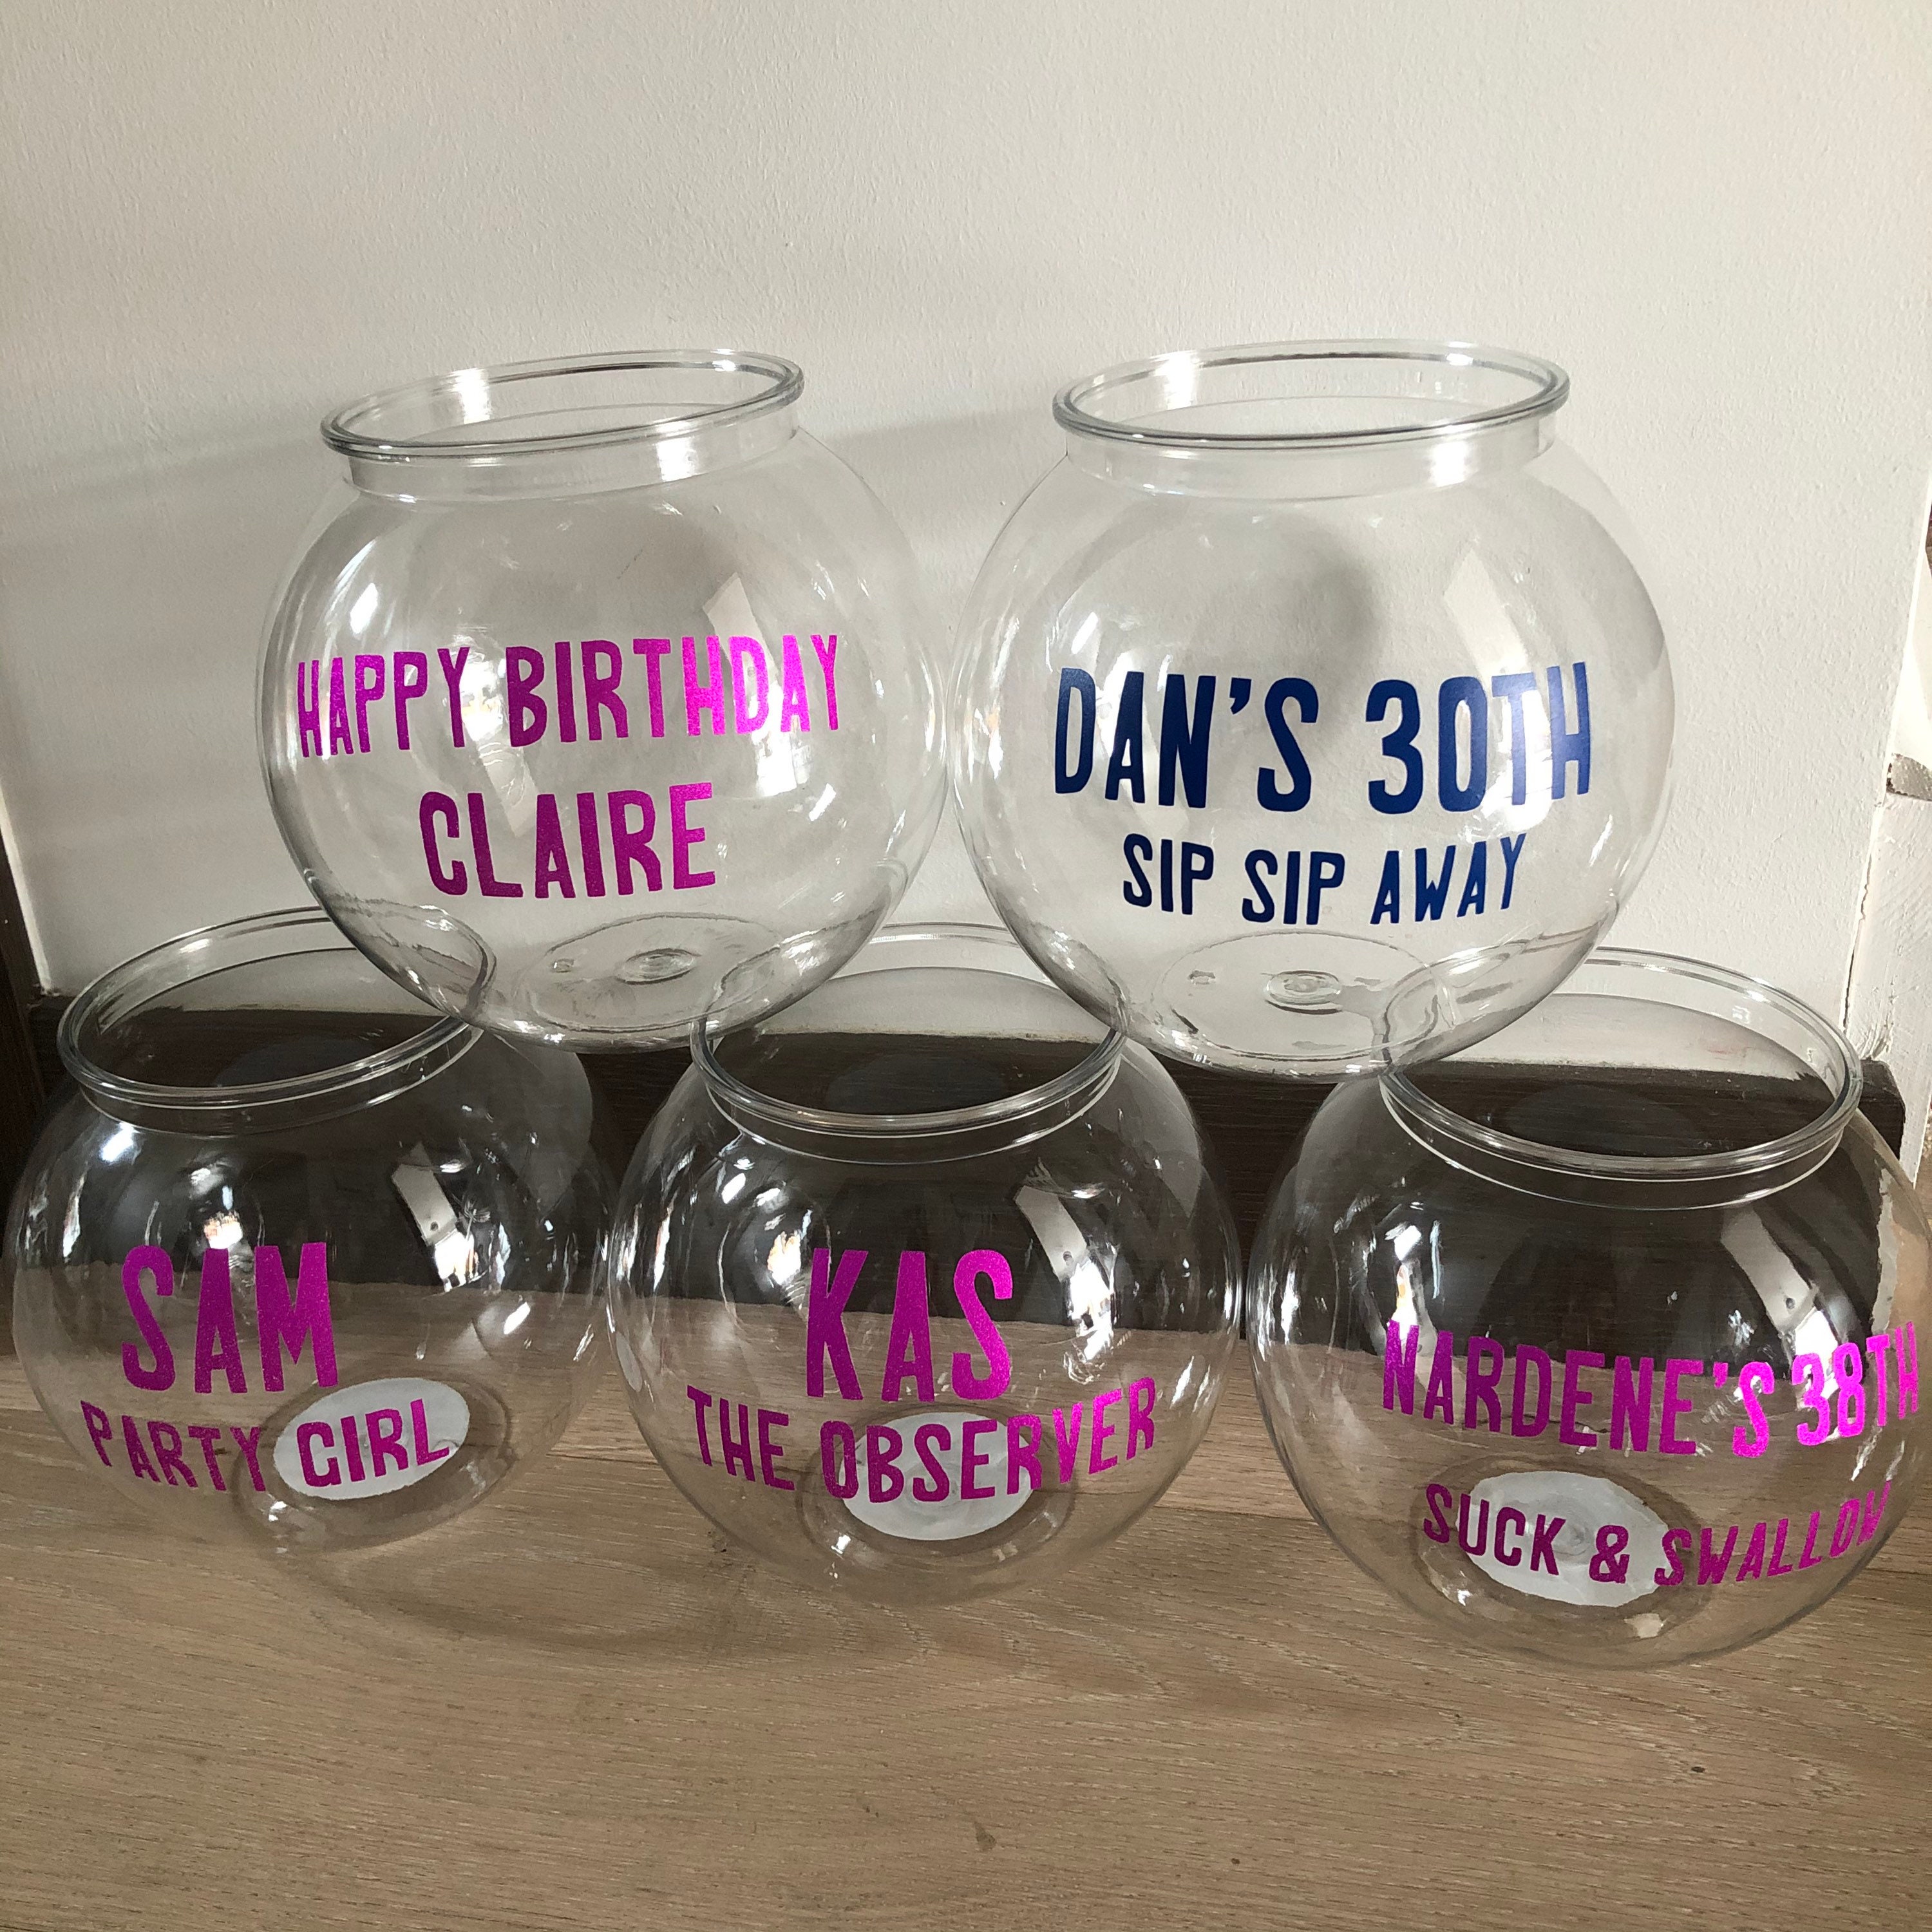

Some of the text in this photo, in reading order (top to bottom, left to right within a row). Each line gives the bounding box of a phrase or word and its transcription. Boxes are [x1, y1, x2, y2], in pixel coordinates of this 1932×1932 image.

[296, 634, 839, 758] HAPPY BIRTHDAY
[1054, 661, 1591, 815] DAN'S 30TH
[419, 781, 717, 899] CLAIRE
[1122, 833, 1527, 925] SIP SIP AWAY
[120, 1240, 339, 1394] SAM
[805, 1246, 1014, 1403] KAS
[80, 1397, 450, 1492] PARTY GIRL
[686, 1376, 1157, 1504] THE OBSERVER
[1381, 1318, 1920, 1459] NARDENE'S 38TH
[1423, 1480, 1892, 1587] SUCK & SWALLOW
